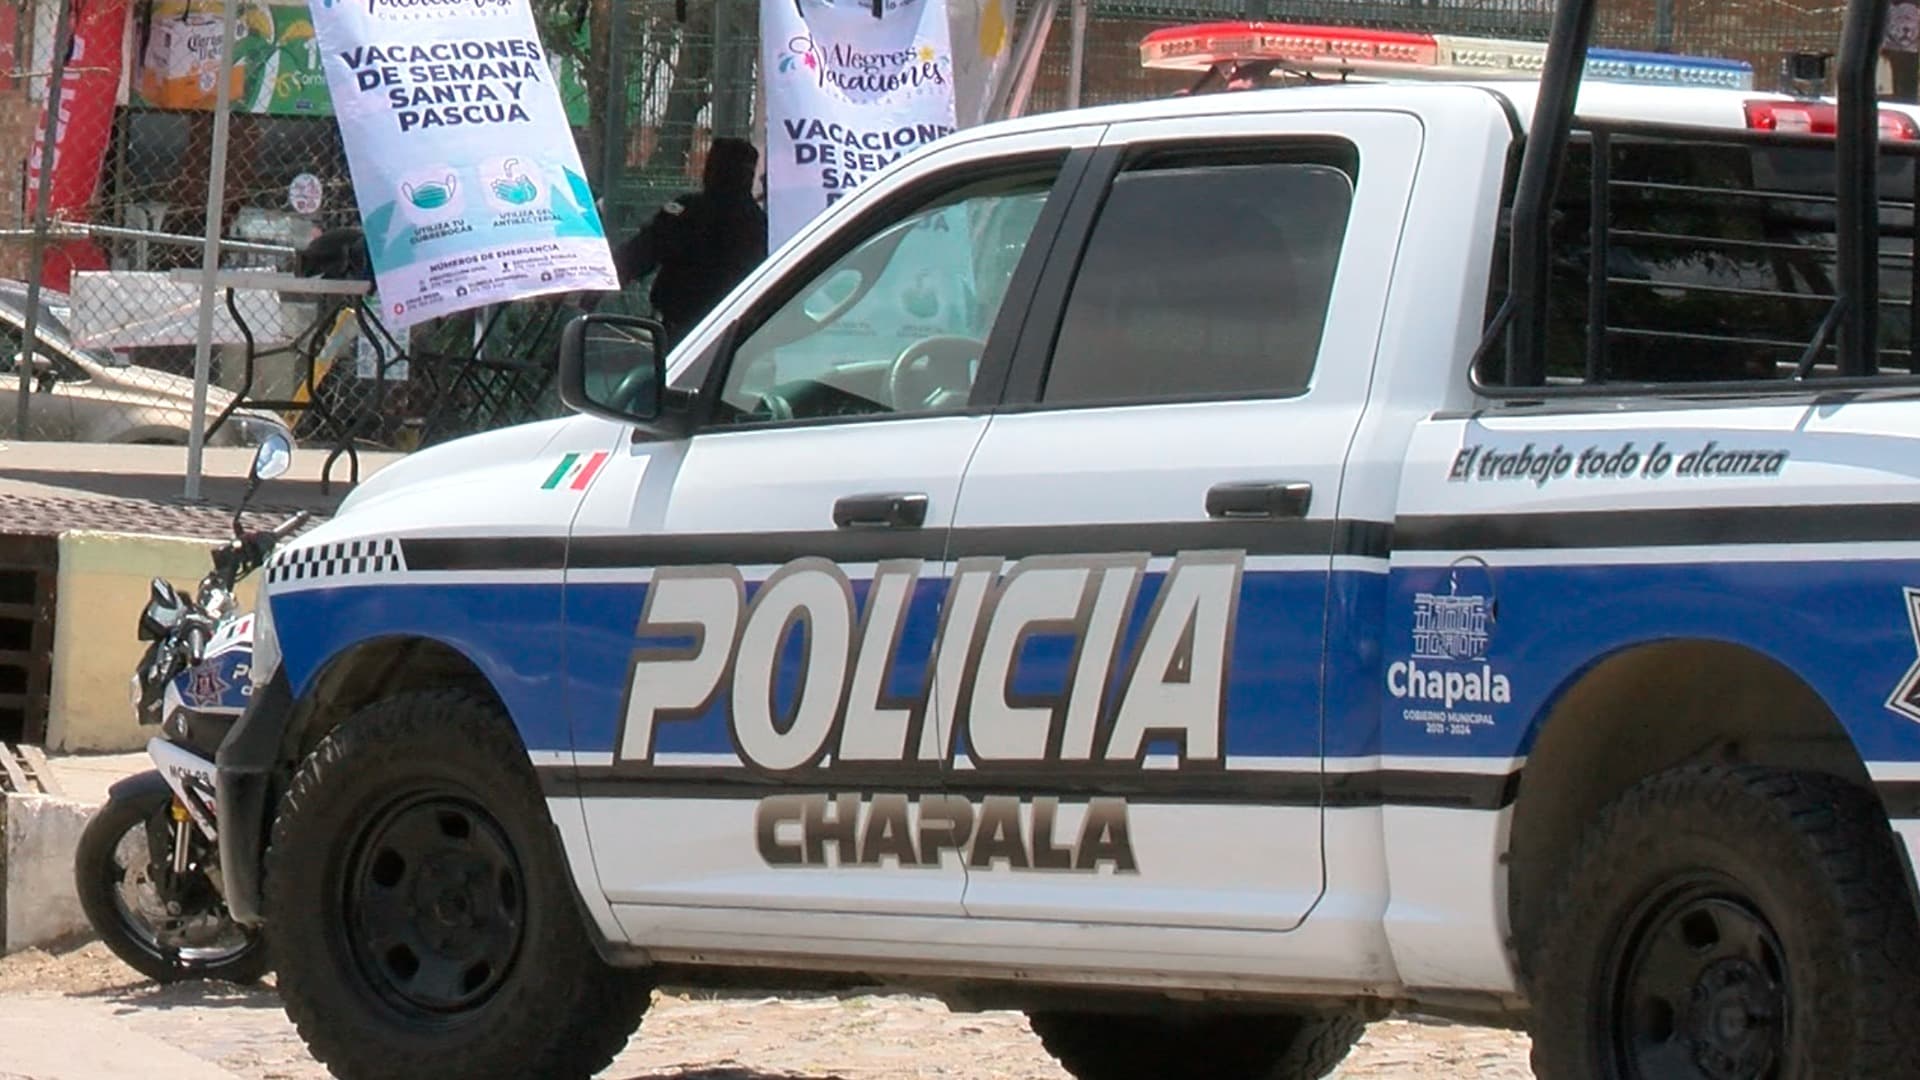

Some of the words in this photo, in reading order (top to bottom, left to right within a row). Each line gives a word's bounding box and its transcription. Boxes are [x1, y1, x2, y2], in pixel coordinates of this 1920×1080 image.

[341, 39, 541, 70] VACACIONES
[789, 33, 945, 92] Vacaciones
[827, 42, 918, 73] Alegres
[357, 66, 402, 92] DE
[409, 60, 540, 83] SEMANA
[389, 83, 494, 109] SANTA
[502, 81, 522, 100] Y
[398, 103, 530, 132] PASCUA
[784, 118, 955, 150] VACACIONE
[794, 143, 837, 165] DE
[1449, 447, 1478, 481] El
[1478, 443, 1574, 488] trabajo
[1575, 441, 1640, 477] todo
[1641, 441, 1674, 476] lo
[1676, 440, 1790, 476] alcanza
[613, 549, 1246, 771] POLICIA
[1387, 660, 1511, 709] Chapala
[1403, 709, 1446, 722] GOBIERNO
[1447, 711, 1495, 725] MUNICIPAL
[755, 792, 1141, 875] CHAPALA
